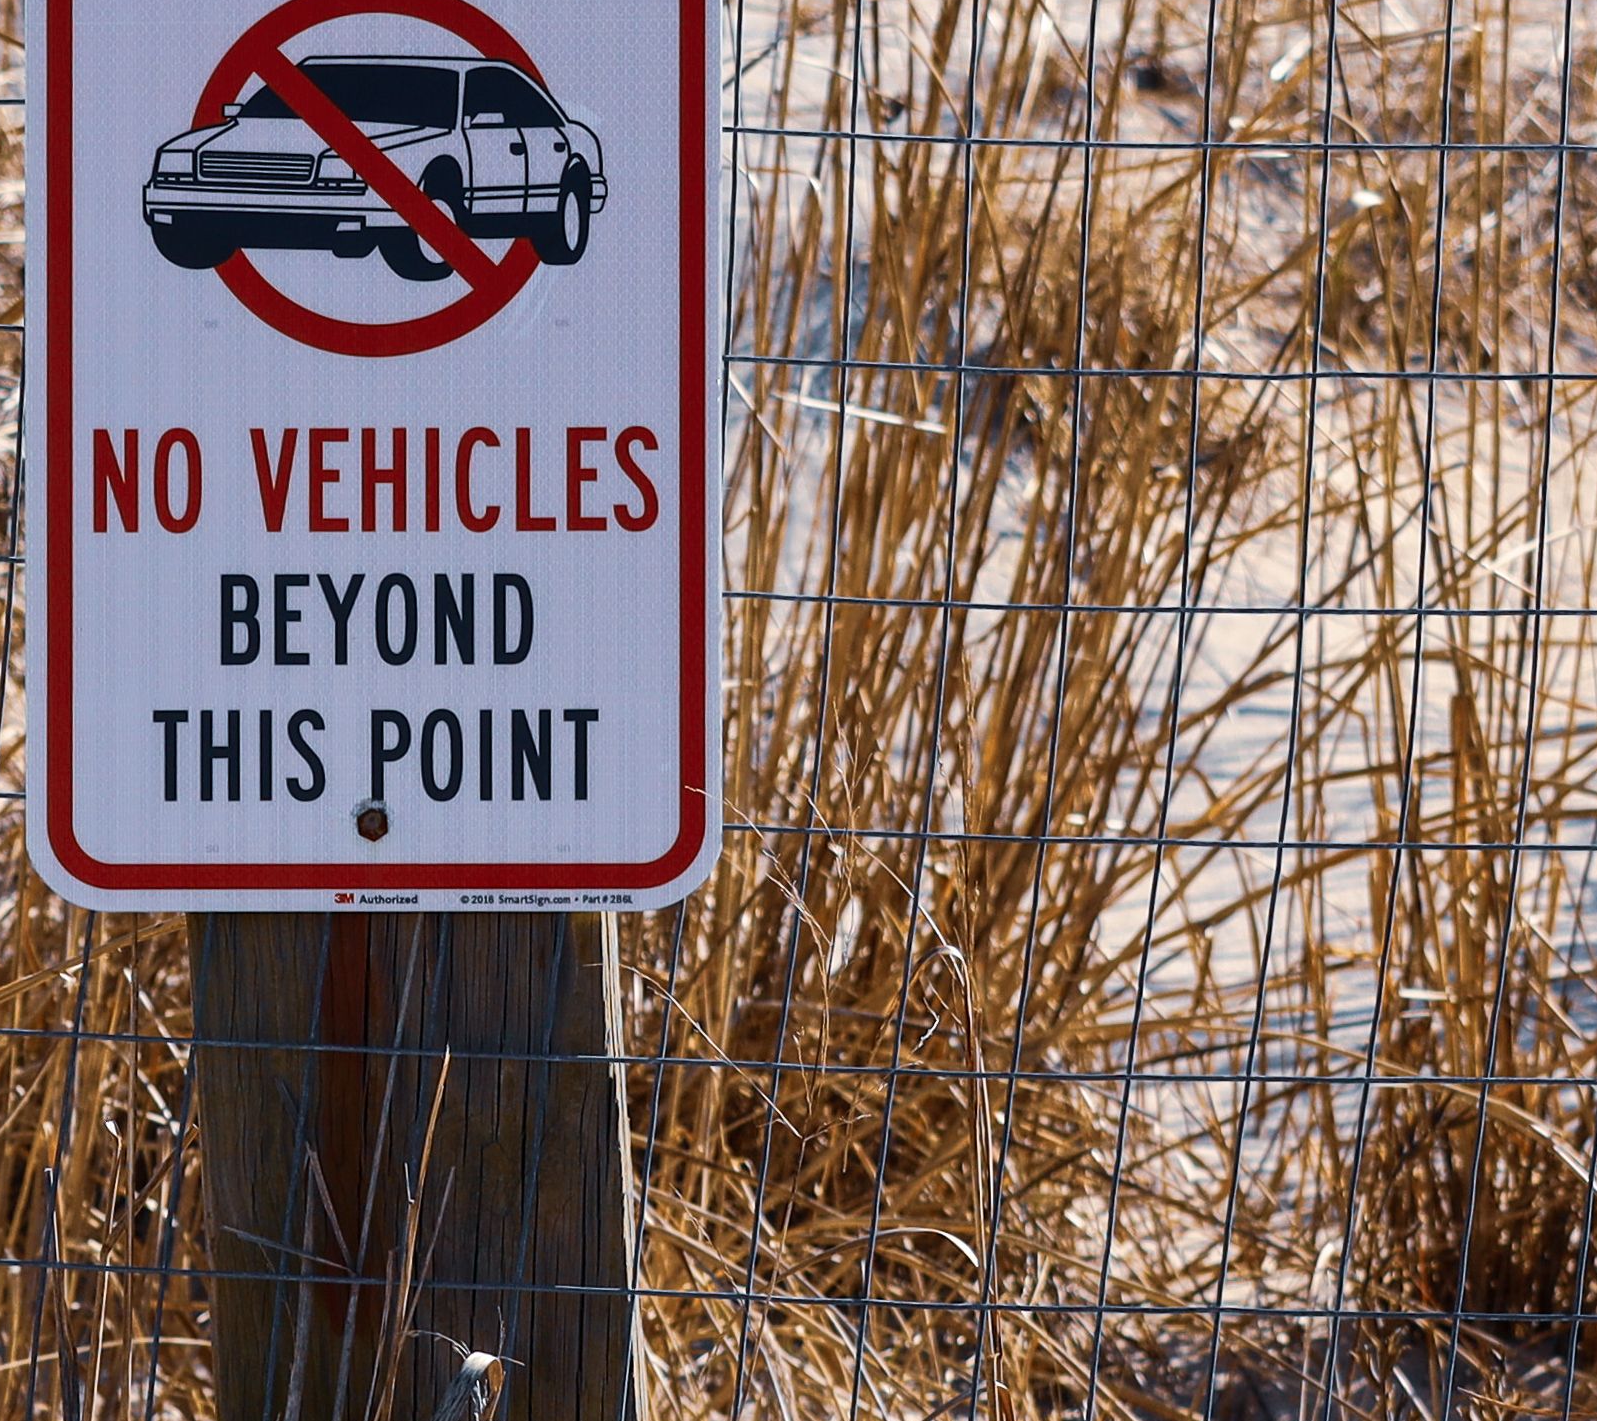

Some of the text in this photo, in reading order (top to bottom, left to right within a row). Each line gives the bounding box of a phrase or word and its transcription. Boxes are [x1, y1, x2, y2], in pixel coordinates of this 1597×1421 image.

[91, 424, 661, 535] NO VEHICLES
[219, 571, 536, 667] BEYOND
[151, 707, 601, 804] THIS POINT
[334, 893, 419, 905] 3M Authorized
[498, 894, 571, 907] SmartSign.com
[582, 894, 601, 905] Part
